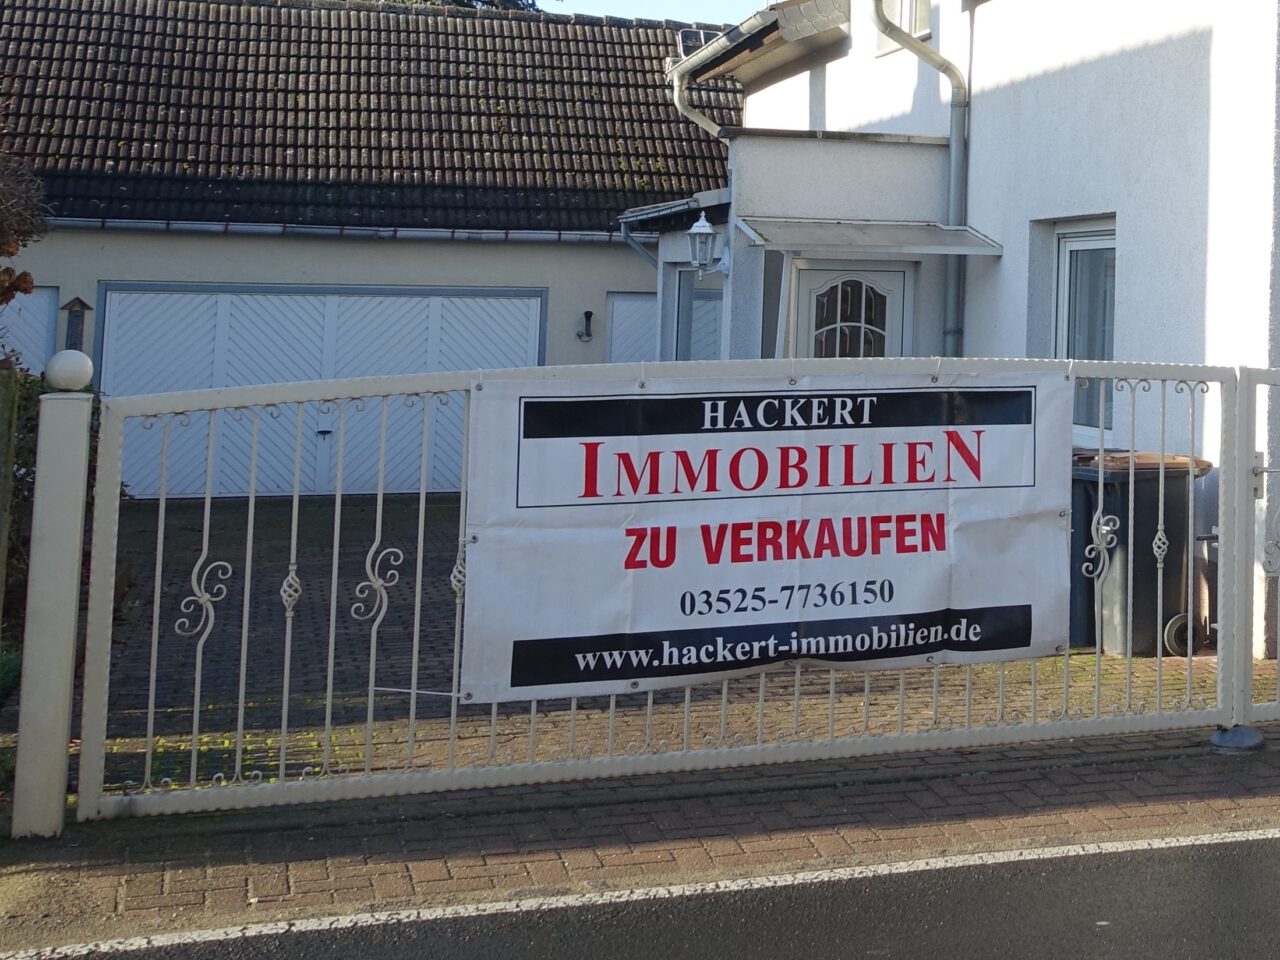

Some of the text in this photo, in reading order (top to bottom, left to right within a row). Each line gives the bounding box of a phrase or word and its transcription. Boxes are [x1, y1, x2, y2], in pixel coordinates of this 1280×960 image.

[702, 397, 878, 430] HACKERT
[578, 430, 985, 498] IMMOBILIEN
[624, 513, 947, 570] ZU VERKAUFEN
[680, 579, 895, 617] 03525-7736150
[575, 619, 983, 672] www.hackert-immobilien.de
